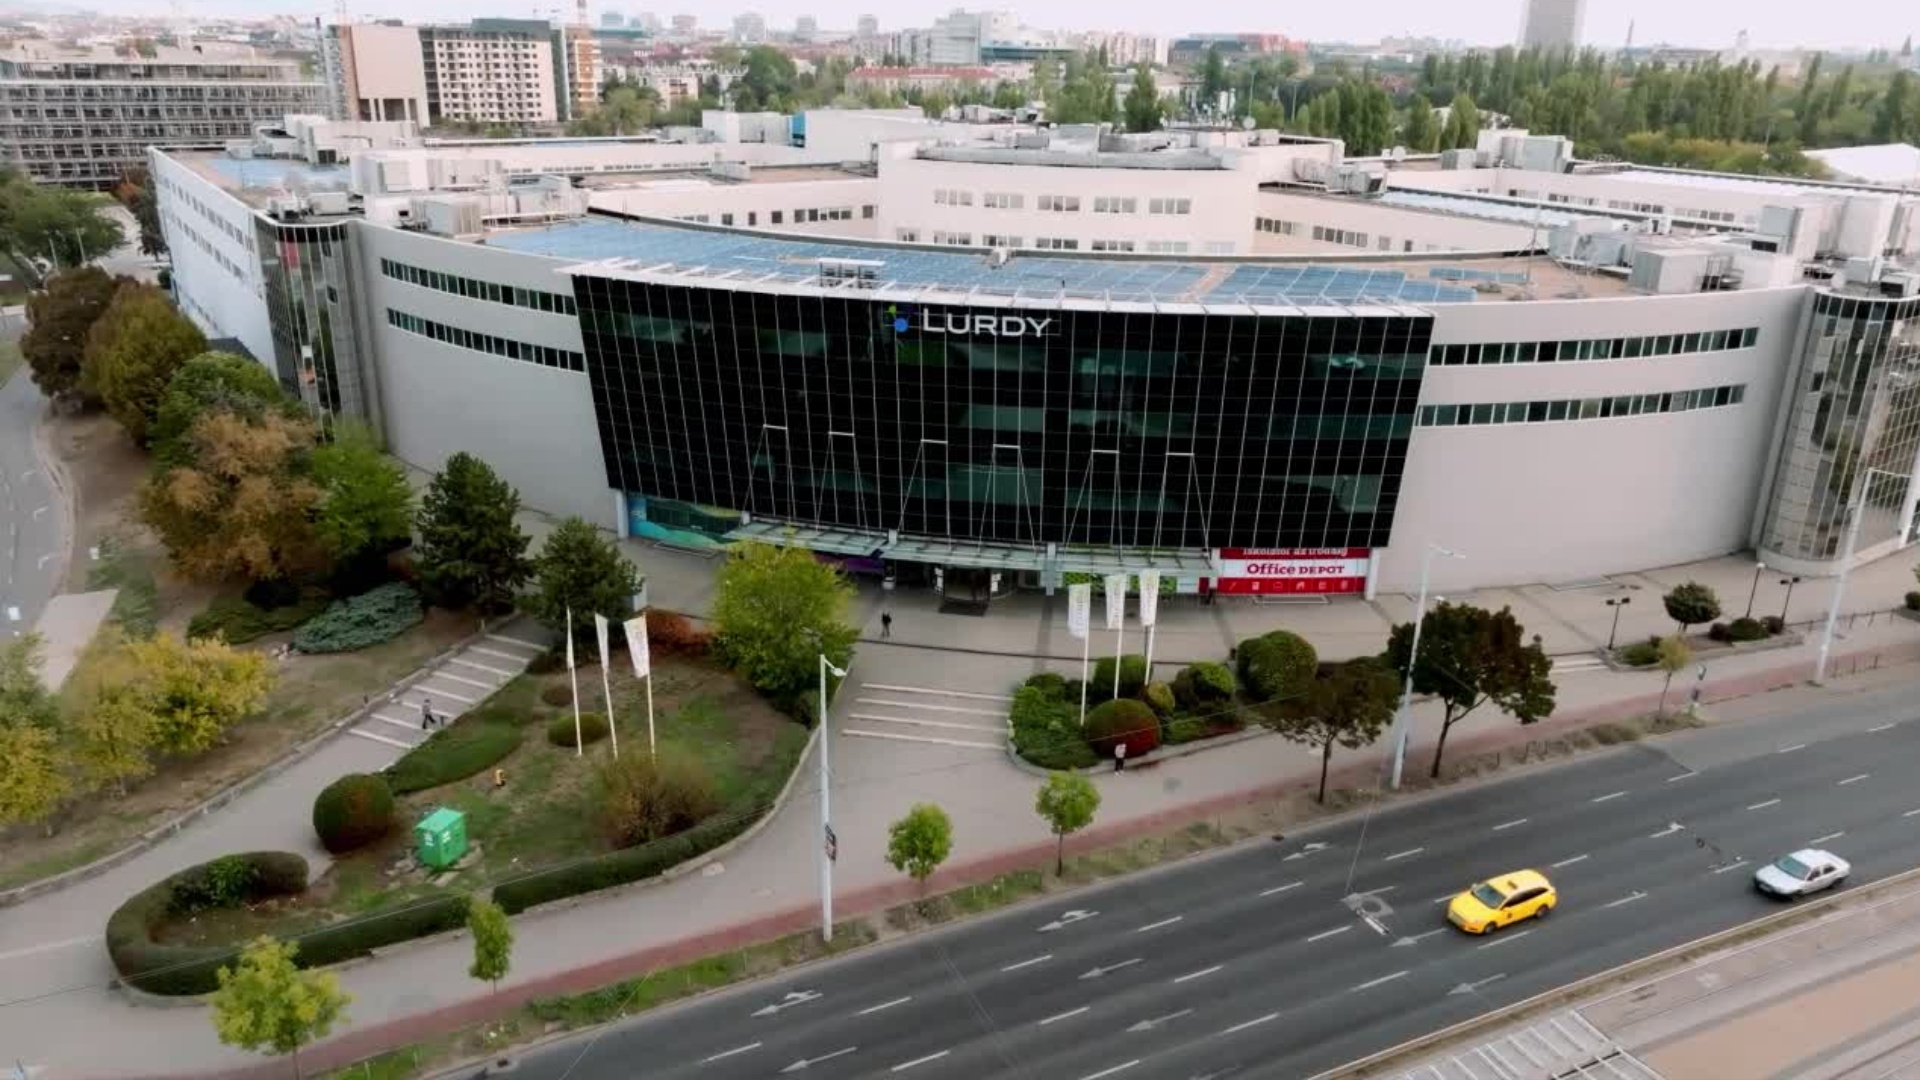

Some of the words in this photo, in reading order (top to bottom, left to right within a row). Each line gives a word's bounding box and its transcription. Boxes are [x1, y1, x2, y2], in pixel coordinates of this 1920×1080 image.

[923, 308, 1052, 338] LURDY
[1247, 563, 1295, 575] Office
[1298, 565, 1345, 575] DEPOT
